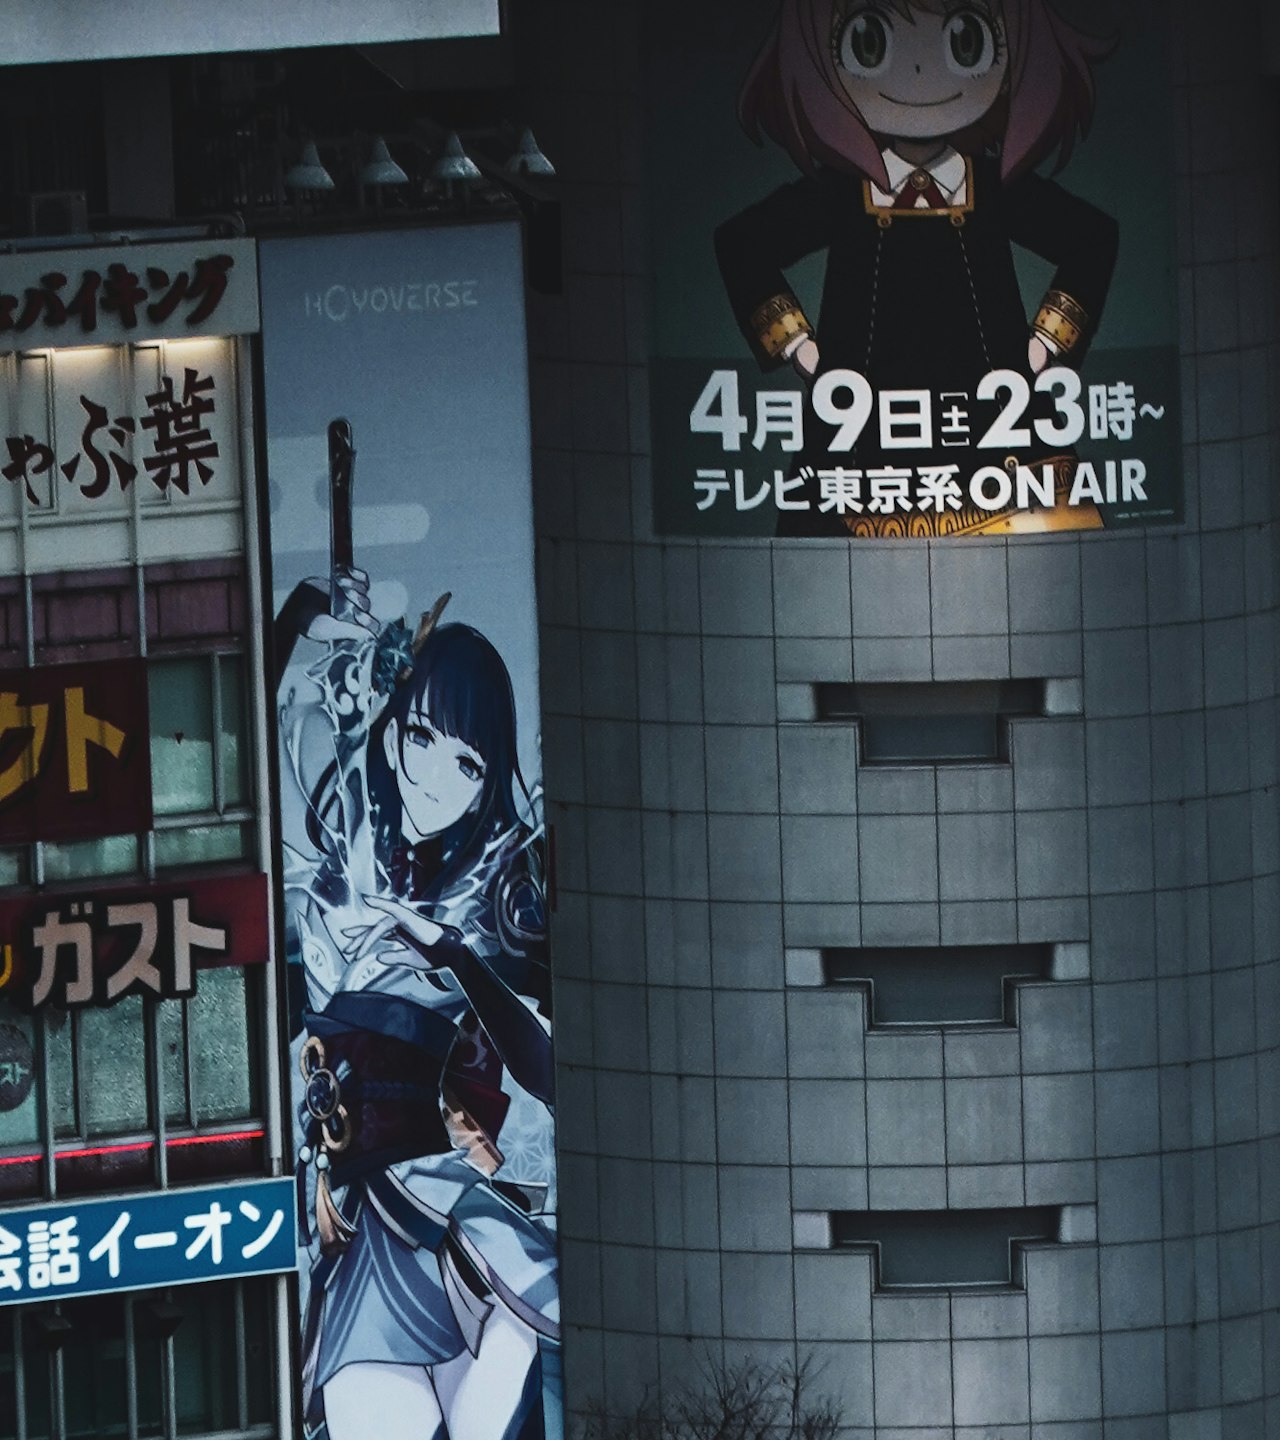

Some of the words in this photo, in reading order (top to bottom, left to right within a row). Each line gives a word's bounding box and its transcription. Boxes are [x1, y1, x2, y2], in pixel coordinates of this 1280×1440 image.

[304, 280, 479, 323] HOYOVERSE
[1067, 457, 1149, 506] AIR
[32, 896, 227, 1007] ガスト
